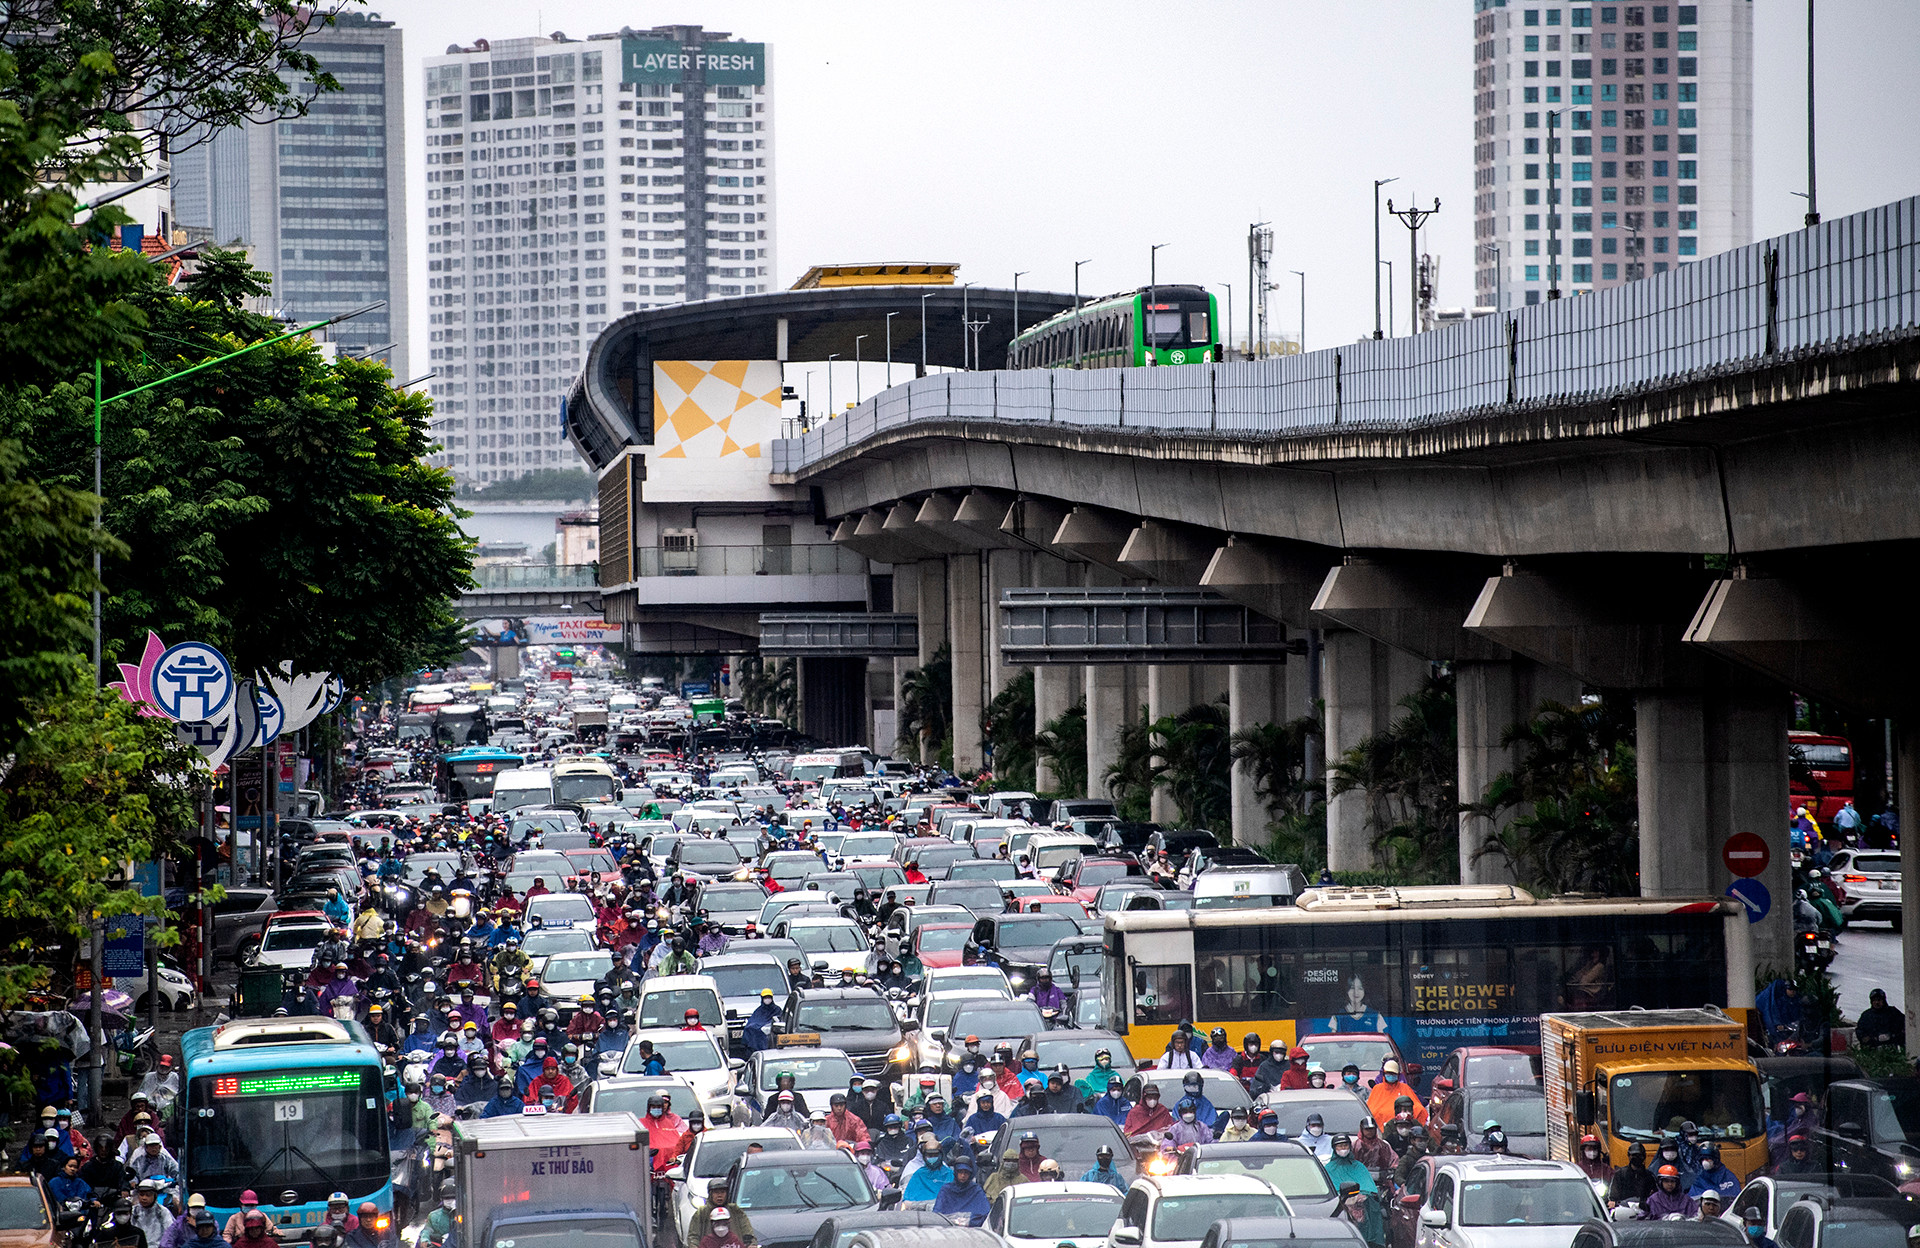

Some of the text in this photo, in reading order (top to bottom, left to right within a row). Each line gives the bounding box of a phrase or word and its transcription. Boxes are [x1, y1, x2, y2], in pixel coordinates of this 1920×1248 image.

[633, 53, 754, 71] LAYER FRESH
[558, 620, 583, 629] TAXI
[572, 631, 604, 639] VNPAY
[1414, 984, 1515, 998] THE DEWEY
[1415, 999, 1498, 1011] SCHOOLS
[1448, 1018, 1464, 1026] HỌC
[1434, 1028, 1458, 1037] DUY
[1595, 1040, 1734, 1054] BƯU ĐIỆN VIỆT NAM
[215, 1078, 238, 1094] 19
[280, 1105, 297, 1118] 19
[532, 1157, 594, 1175] XE THƯ BÁO
